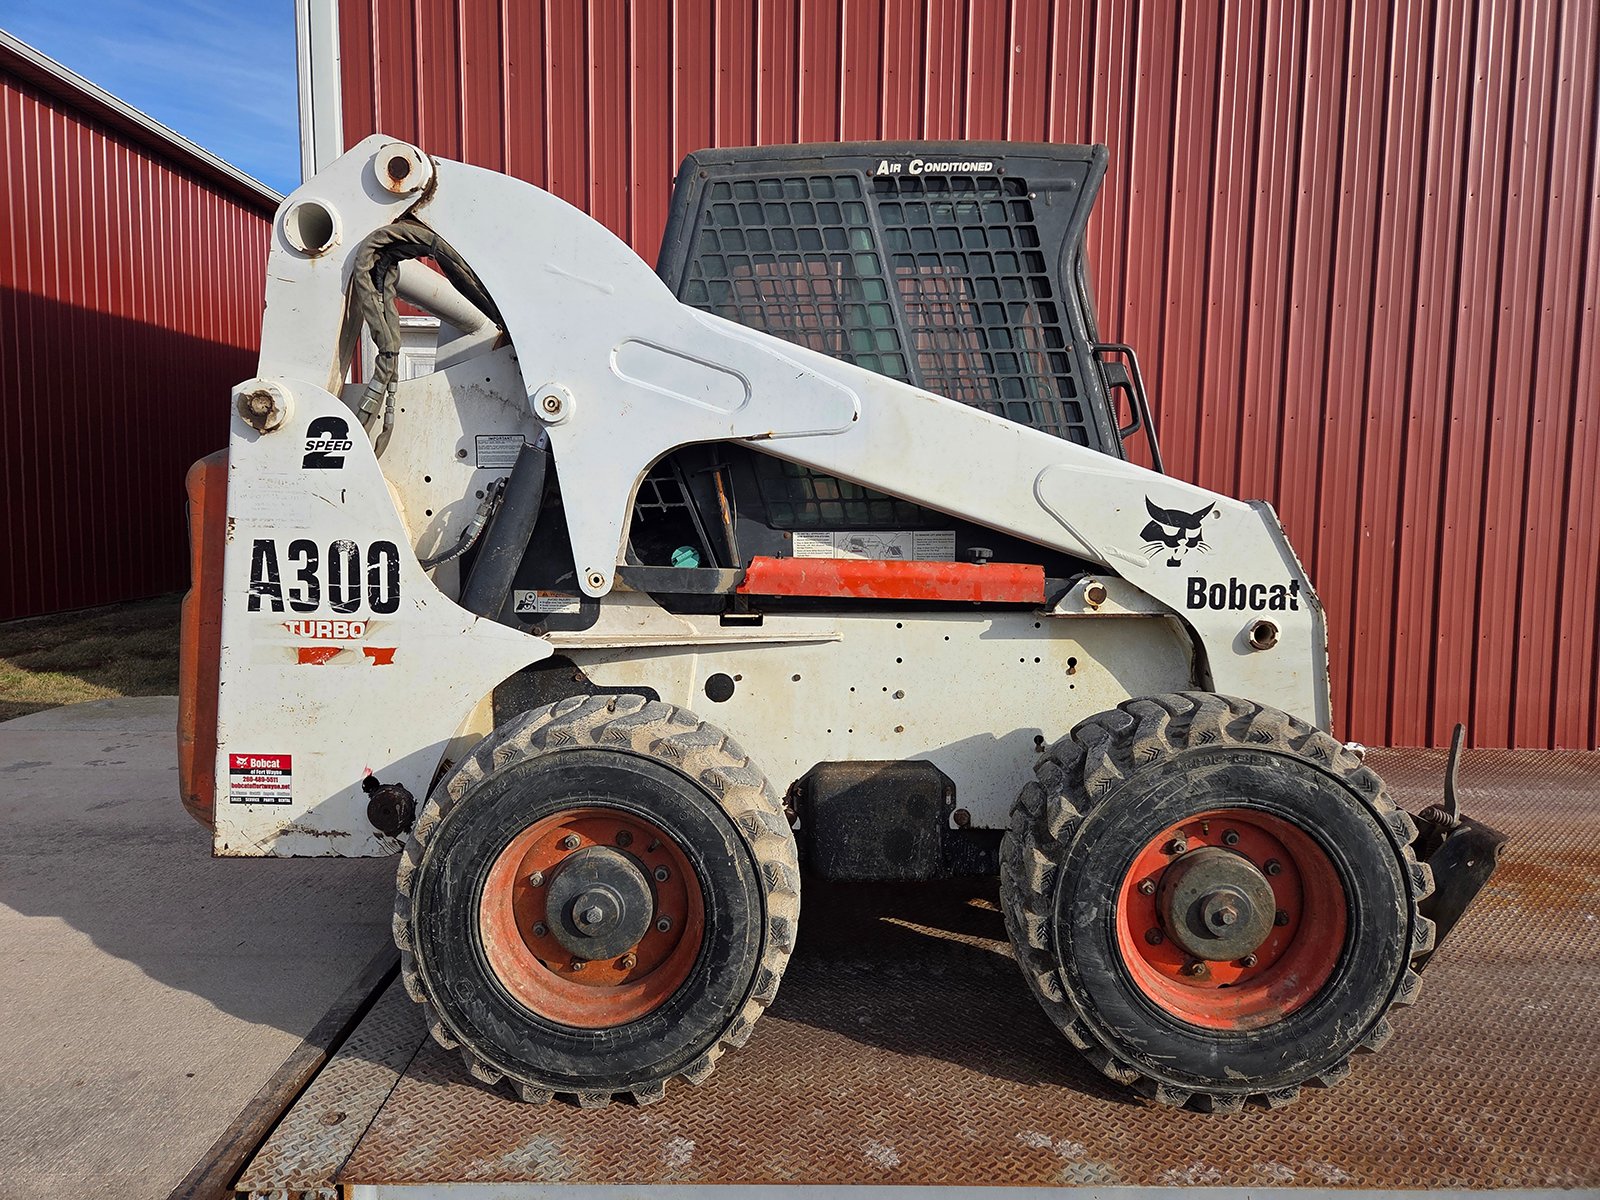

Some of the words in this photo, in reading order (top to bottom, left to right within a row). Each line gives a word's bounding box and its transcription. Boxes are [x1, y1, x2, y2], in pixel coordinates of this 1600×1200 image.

[876, 160, 902, 175] AIR
[908, 159, 993, 175] CONDITIONED
[302, 416, 349, 469] 2
[304, 440, 353, 451] SPEED
[247, 539, 401, 614] A300
[1186, 577, 1300, 611] Bobcat
[285, 620, 366, 639] TURBO
[250, 758, 280, 768] Bobcat
